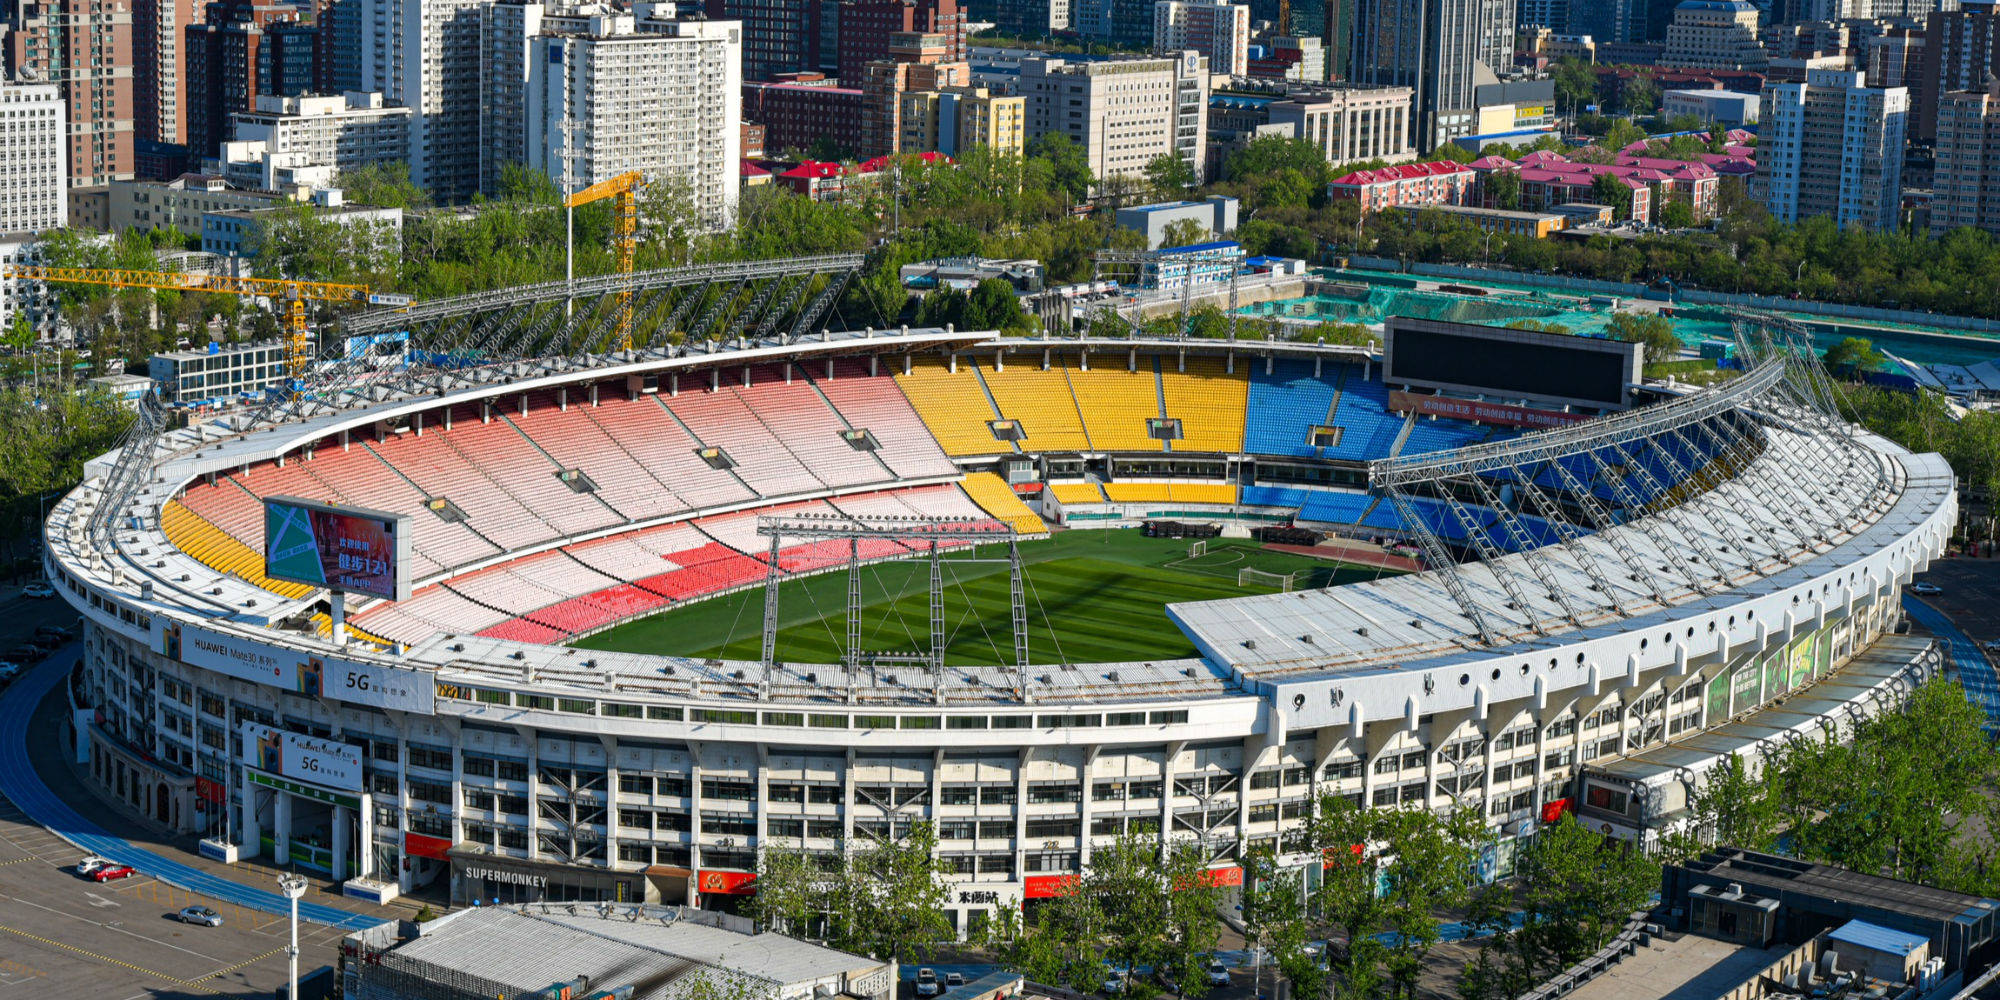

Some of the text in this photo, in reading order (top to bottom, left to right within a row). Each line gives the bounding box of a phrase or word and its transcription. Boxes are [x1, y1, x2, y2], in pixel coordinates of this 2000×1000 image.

[194, 638, 228, 656] HUAWEI
[346, 672, 369, 690] 5G
[302, 756, 318, 771] 5G
[465, 867, 547, 887] SUPERMONKEY
